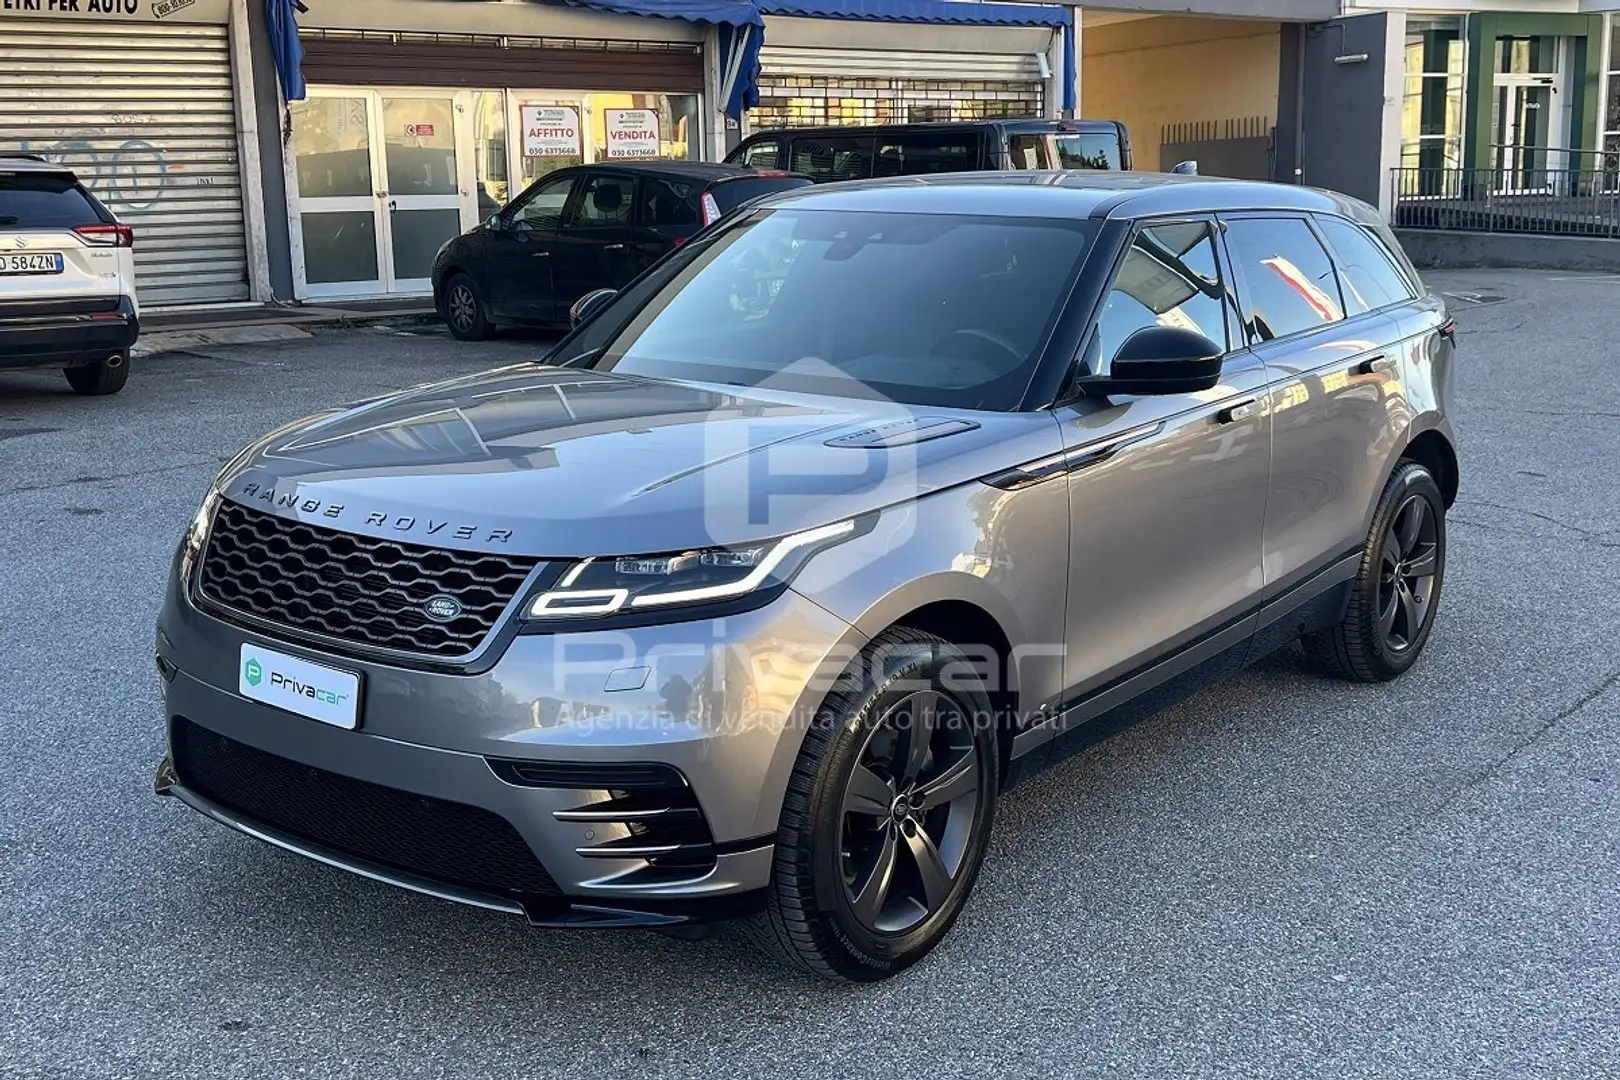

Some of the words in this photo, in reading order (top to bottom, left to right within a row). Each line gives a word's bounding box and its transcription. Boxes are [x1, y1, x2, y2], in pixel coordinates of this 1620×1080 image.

[87, 0, 138, 14] AUTO
[529, 128, 574, 138] AFFITTO
[610, 130, 656, 140] VENDITA
[11, 255, 55, 270] 584ZN
[243, 483, 344, 518] RANGE
[365, 511, 513, 543] ROVER
[270, 671, 348, 706] Privacar
